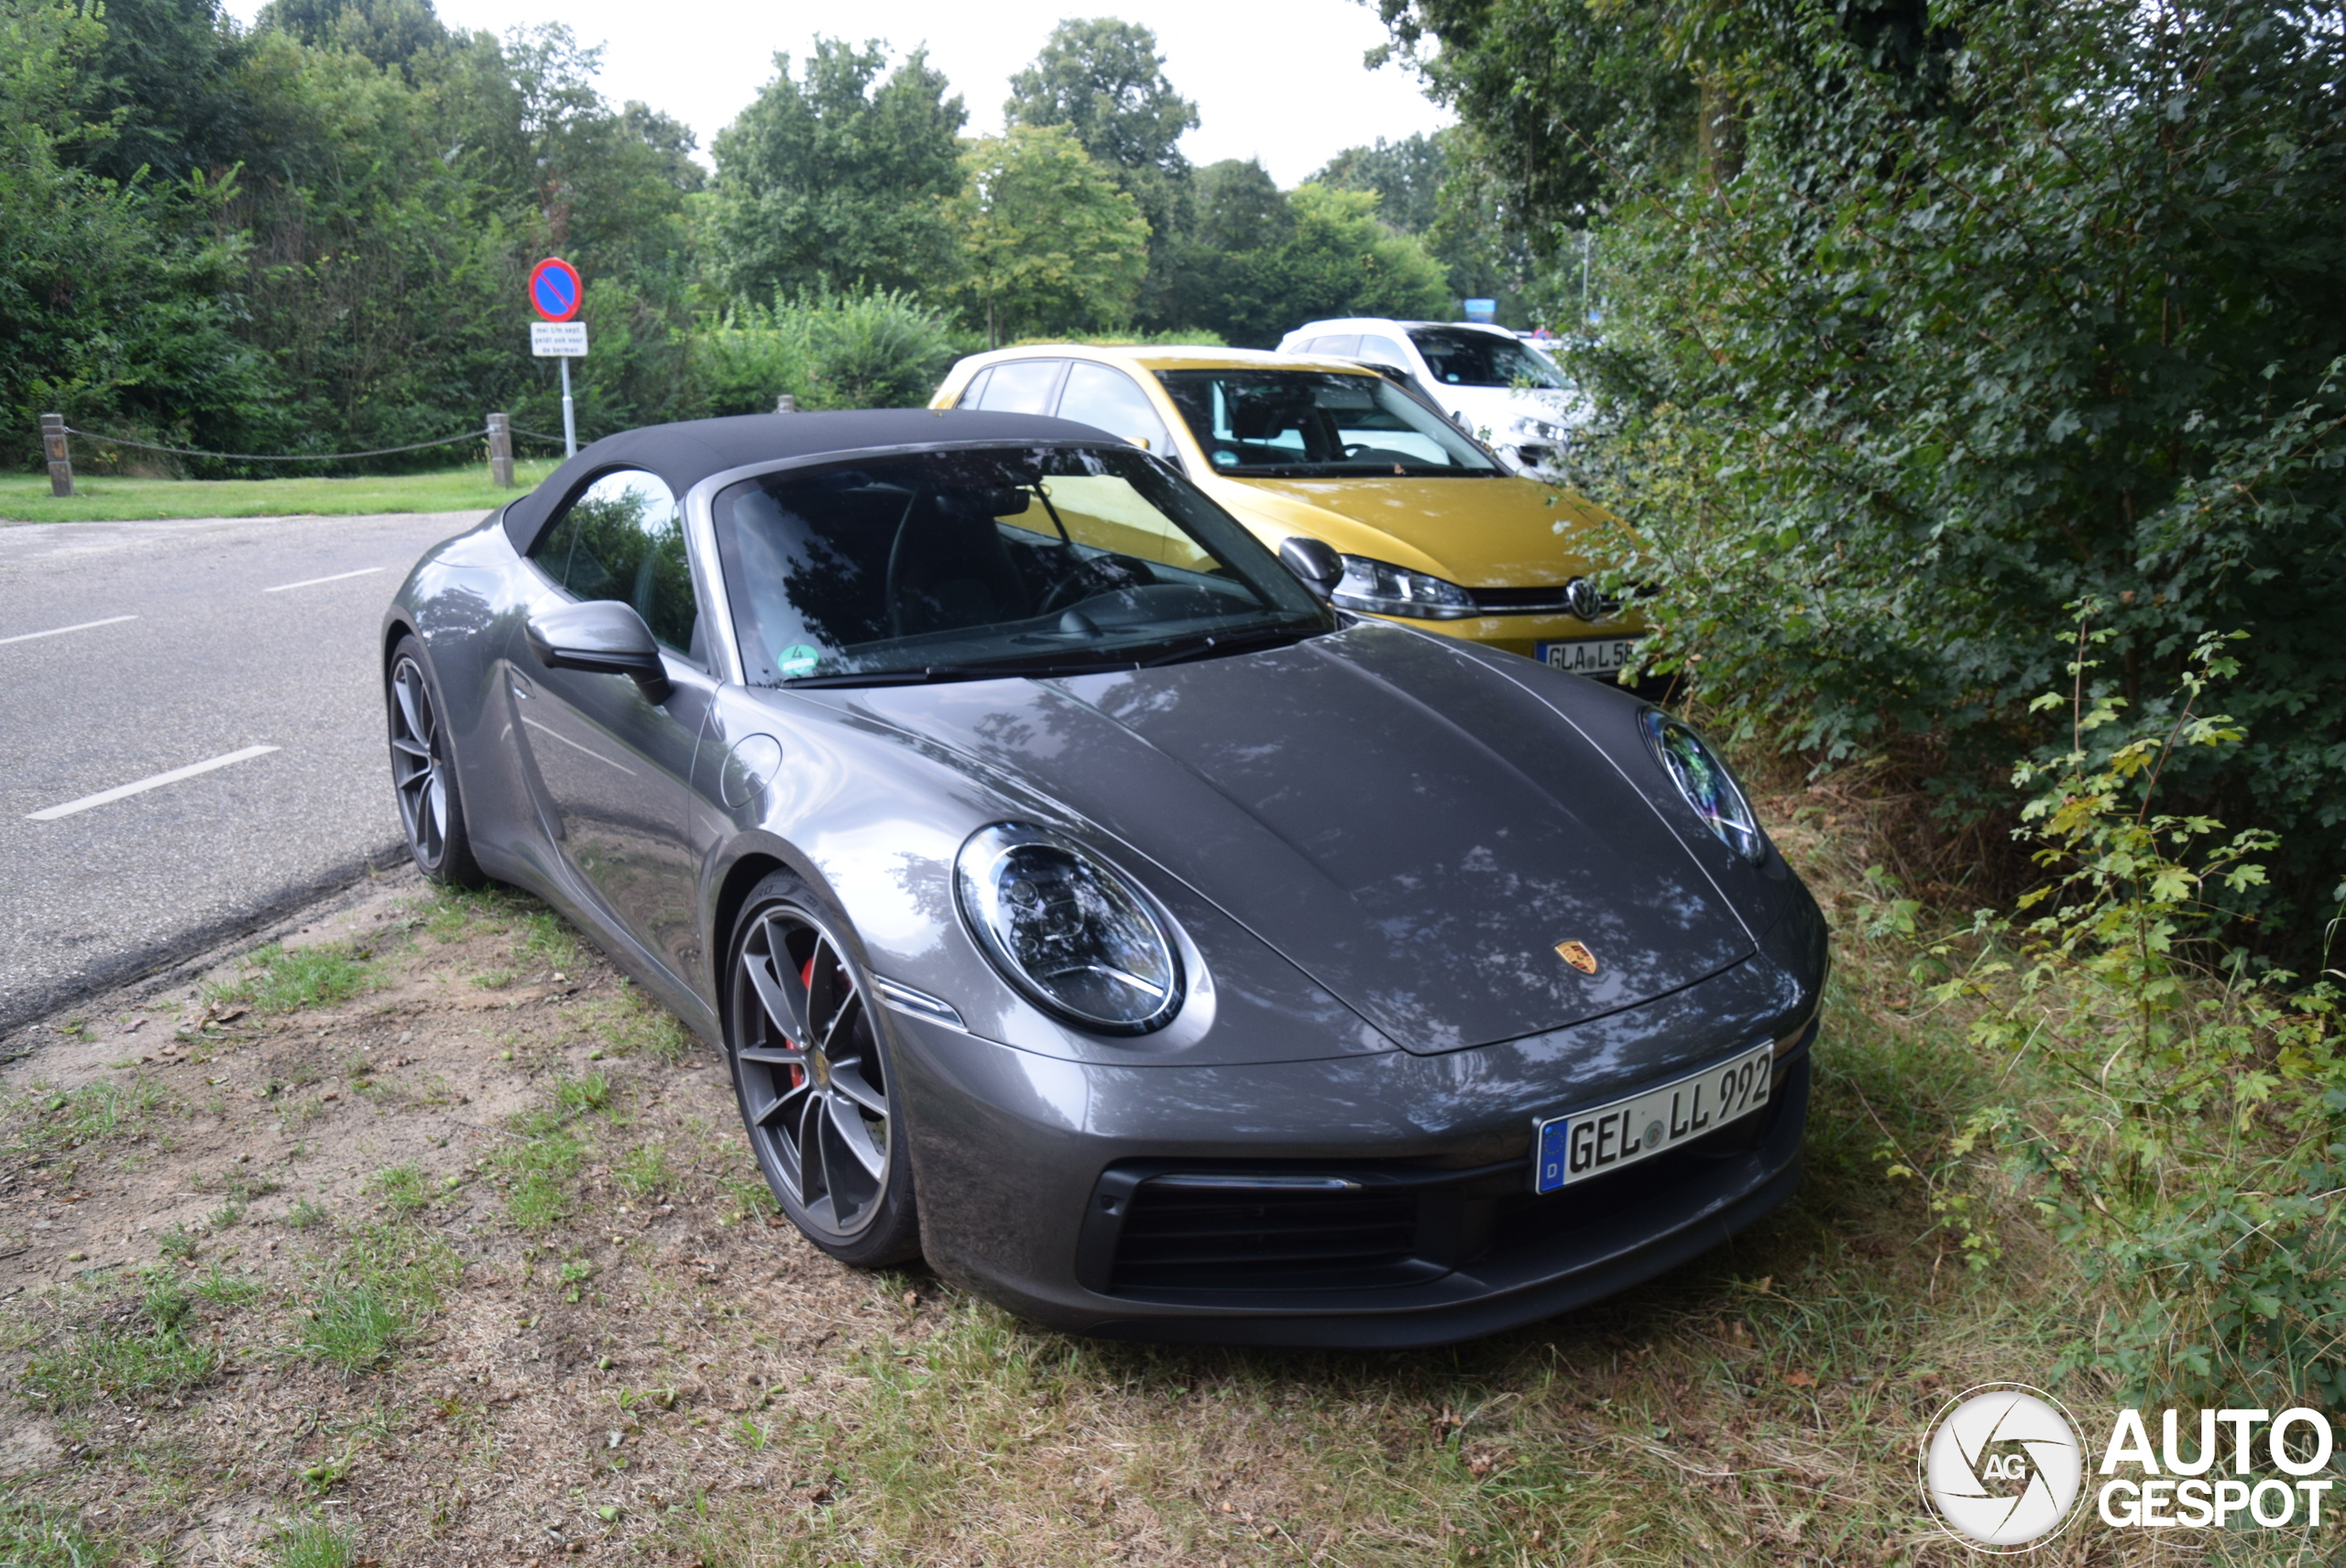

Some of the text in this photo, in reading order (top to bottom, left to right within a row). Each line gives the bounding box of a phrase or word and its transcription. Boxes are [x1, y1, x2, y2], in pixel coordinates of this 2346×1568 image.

[534, 336, 552, 345] geldt
[791, 645, 804, 659] 4
[1549, 645, 1585, 670] GLA
[1599, 643, 1609, 667] L
[1569, 1054, 1770, 1174] GEL LL 992
[1547, 1163, 1558, 1179] D
